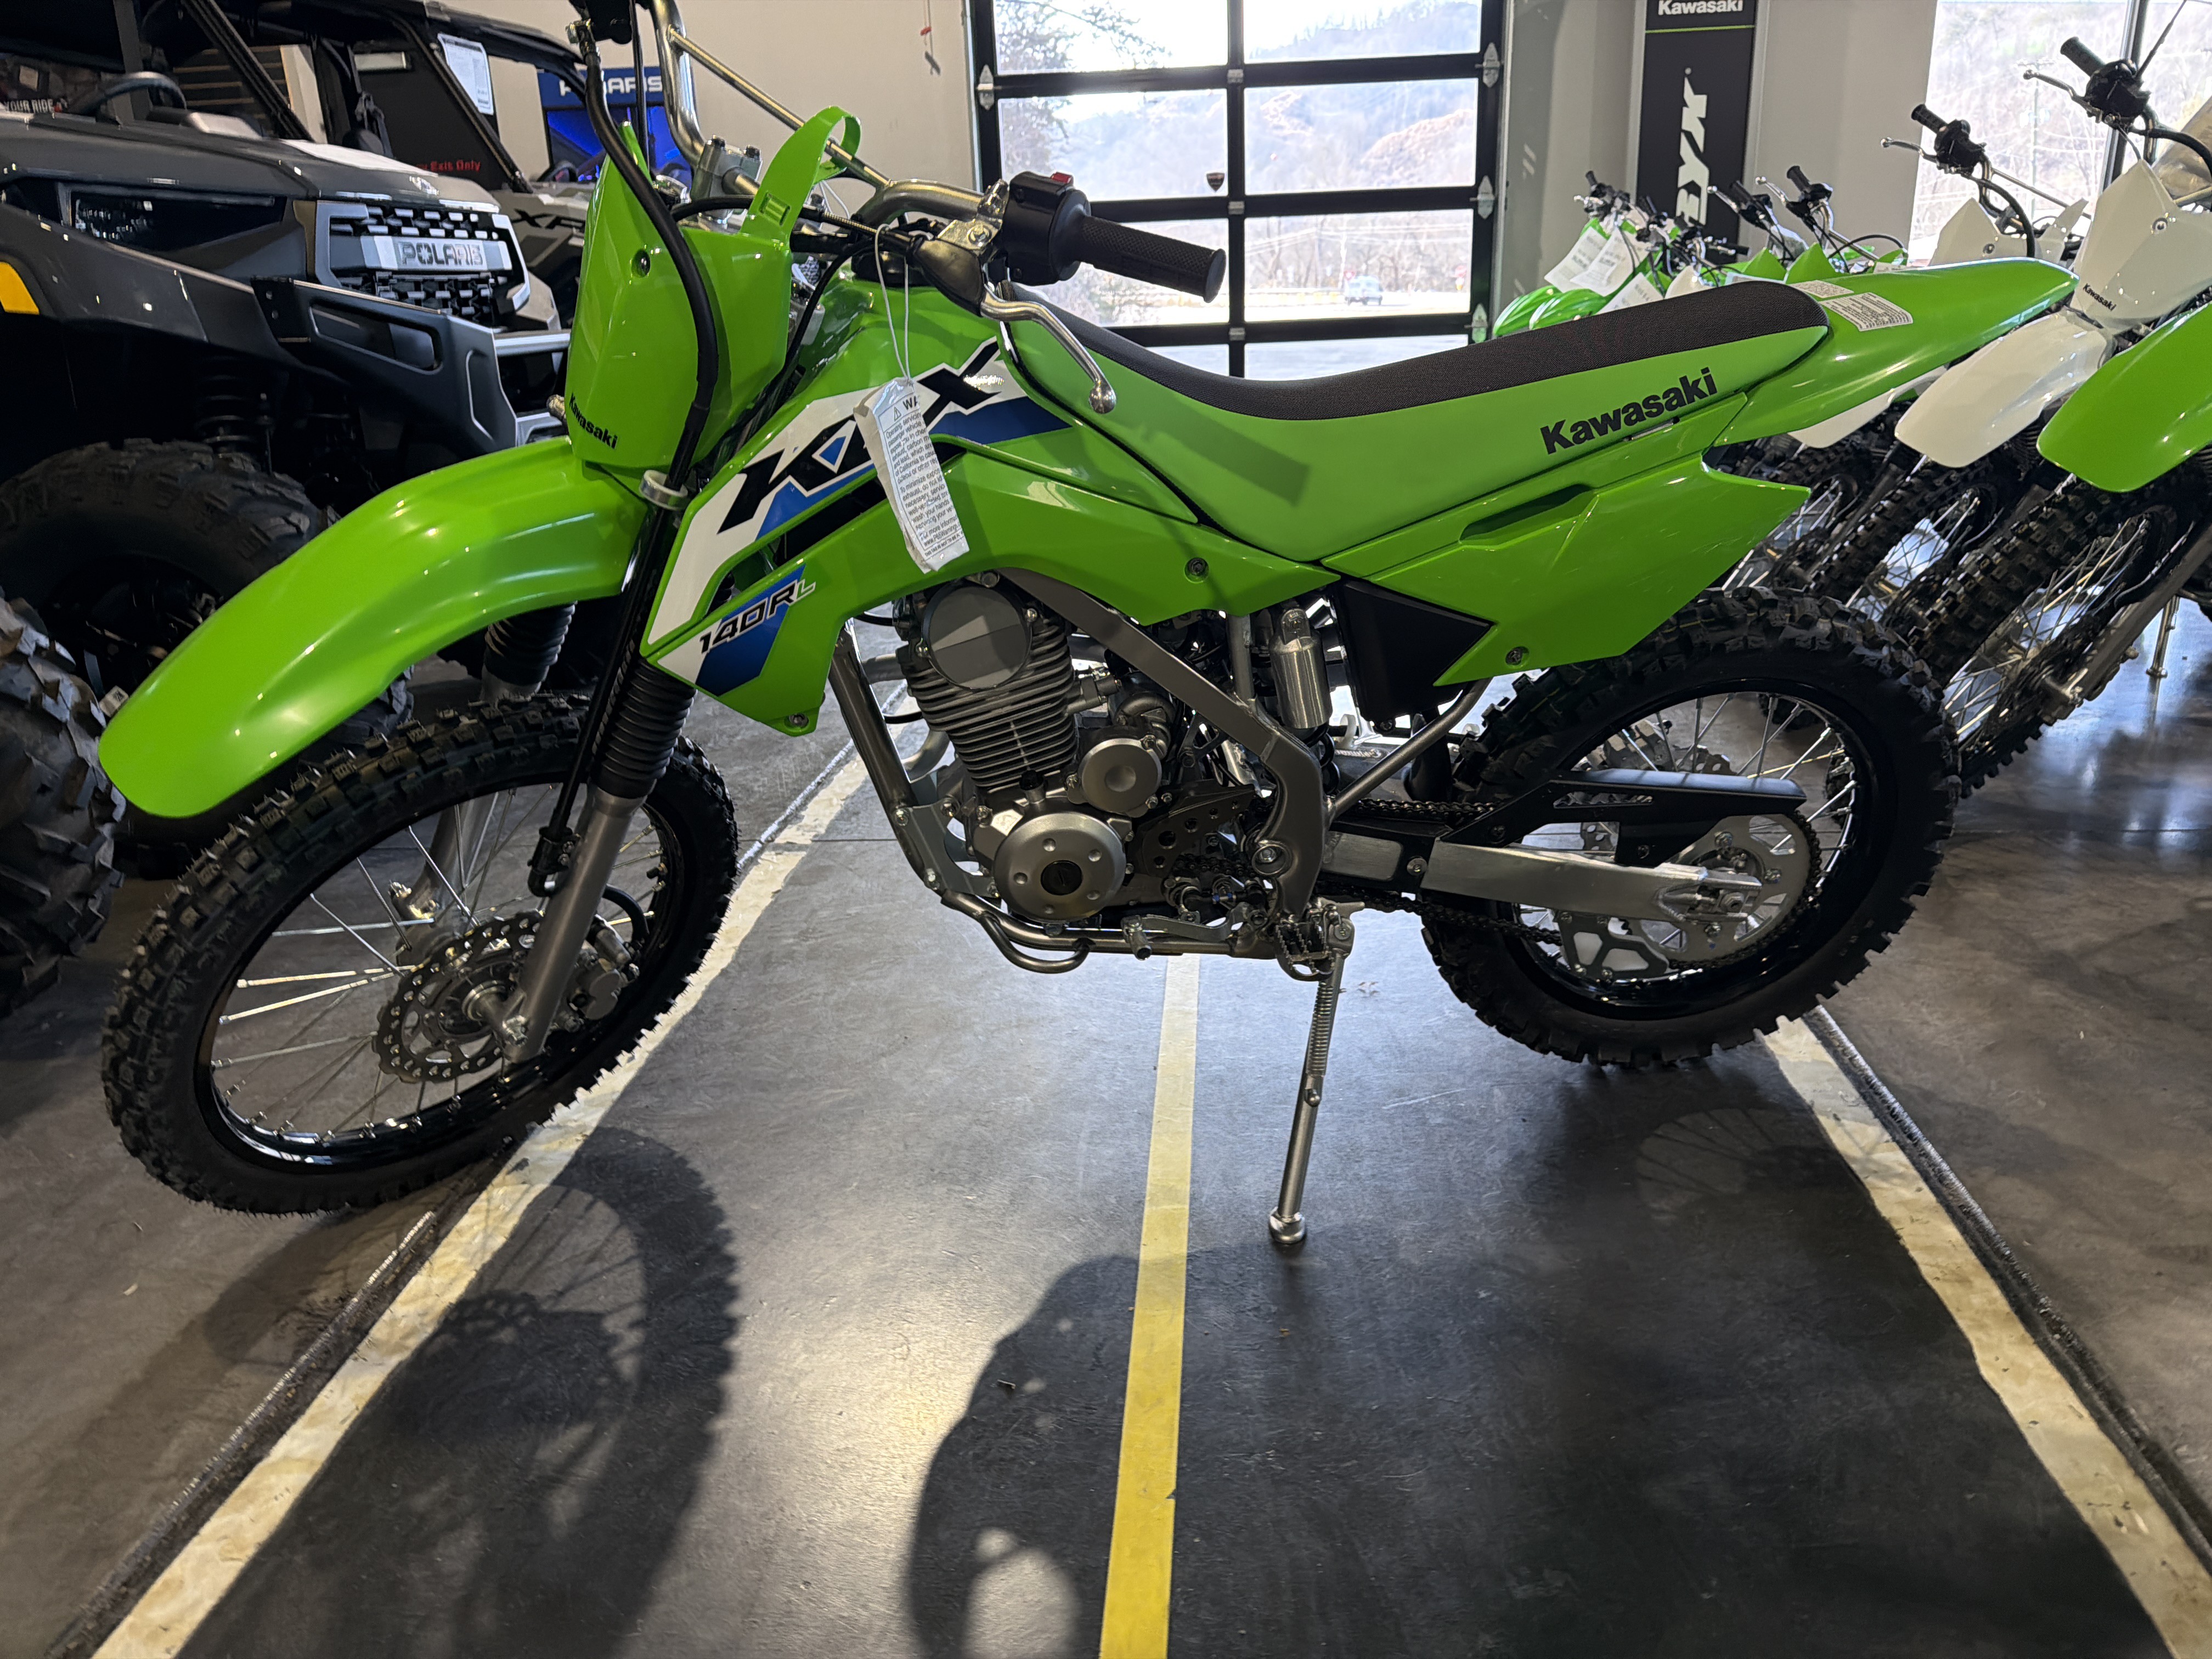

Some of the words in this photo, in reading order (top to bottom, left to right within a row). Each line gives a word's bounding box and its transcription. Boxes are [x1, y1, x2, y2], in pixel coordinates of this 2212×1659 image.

[1658, 0, 1743, 15] Kawasaki
[456, 159, 481, 172] Only
[401, 241, 484, 266] POLARIS
[2083, 283, 2117, 312] Kawasaki
[1540, 367, 1718, 455] Kawasaki
[569, 393, 618, 449] Kawasaki
[905, 421, 922, 432] vehicle
[907, 438, 923, 451] carbon
[902, 486, 922, 501] exhaust,
[929, 478, 937, 487] not
[906, 476, 926, 490] minimize
[905, 492, 931, 509] necessary,
[925, 506, 935, 518] your
[935, 499, 950, 510] hands
[936, 509, 946, 521] your
[929, 525, 941, 535] more
